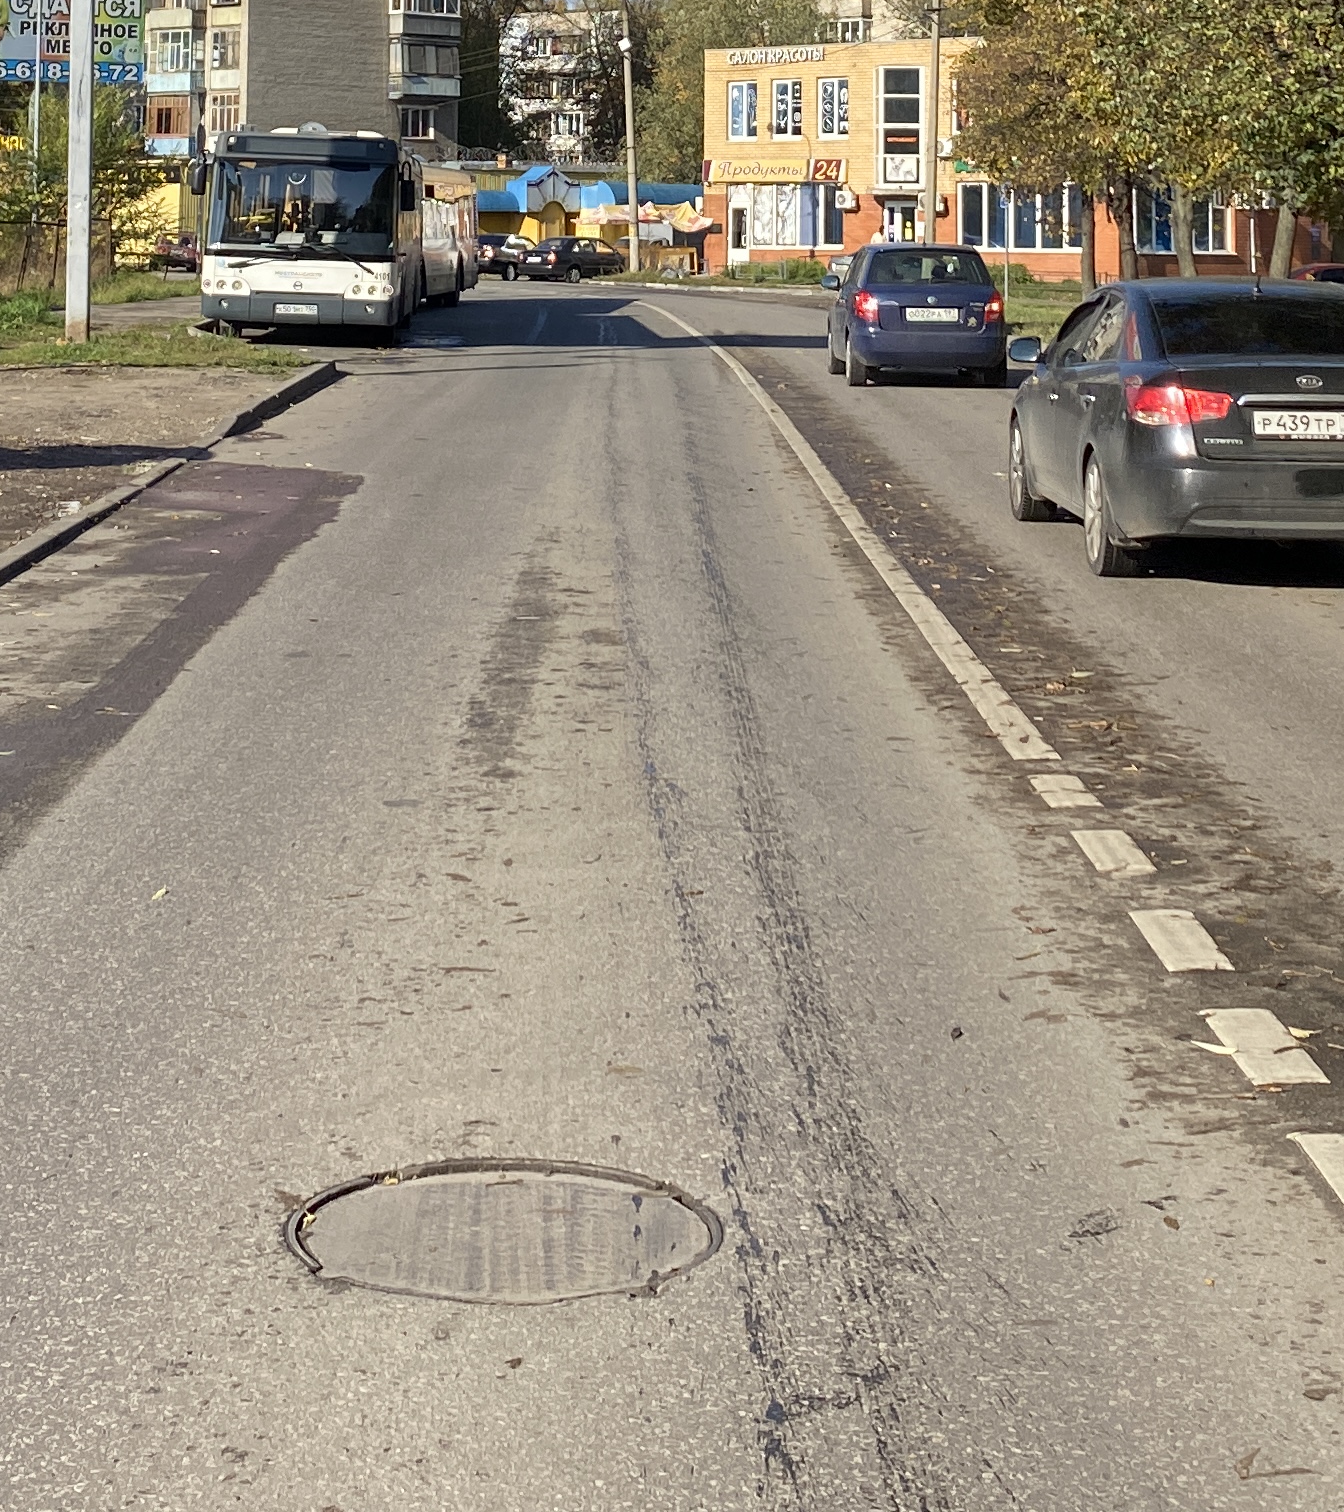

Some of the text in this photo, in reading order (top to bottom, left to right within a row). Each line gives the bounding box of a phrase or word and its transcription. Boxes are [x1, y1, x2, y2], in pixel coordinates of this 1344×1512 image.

[20, 20, 138, 39] РЕКЛНОЕ
[46, 39, 112, 55] МЕО
[727, 47, 825, 65] САЛОН КРАСОТЫ
[718, 160, 838, 180] Продукты 24
